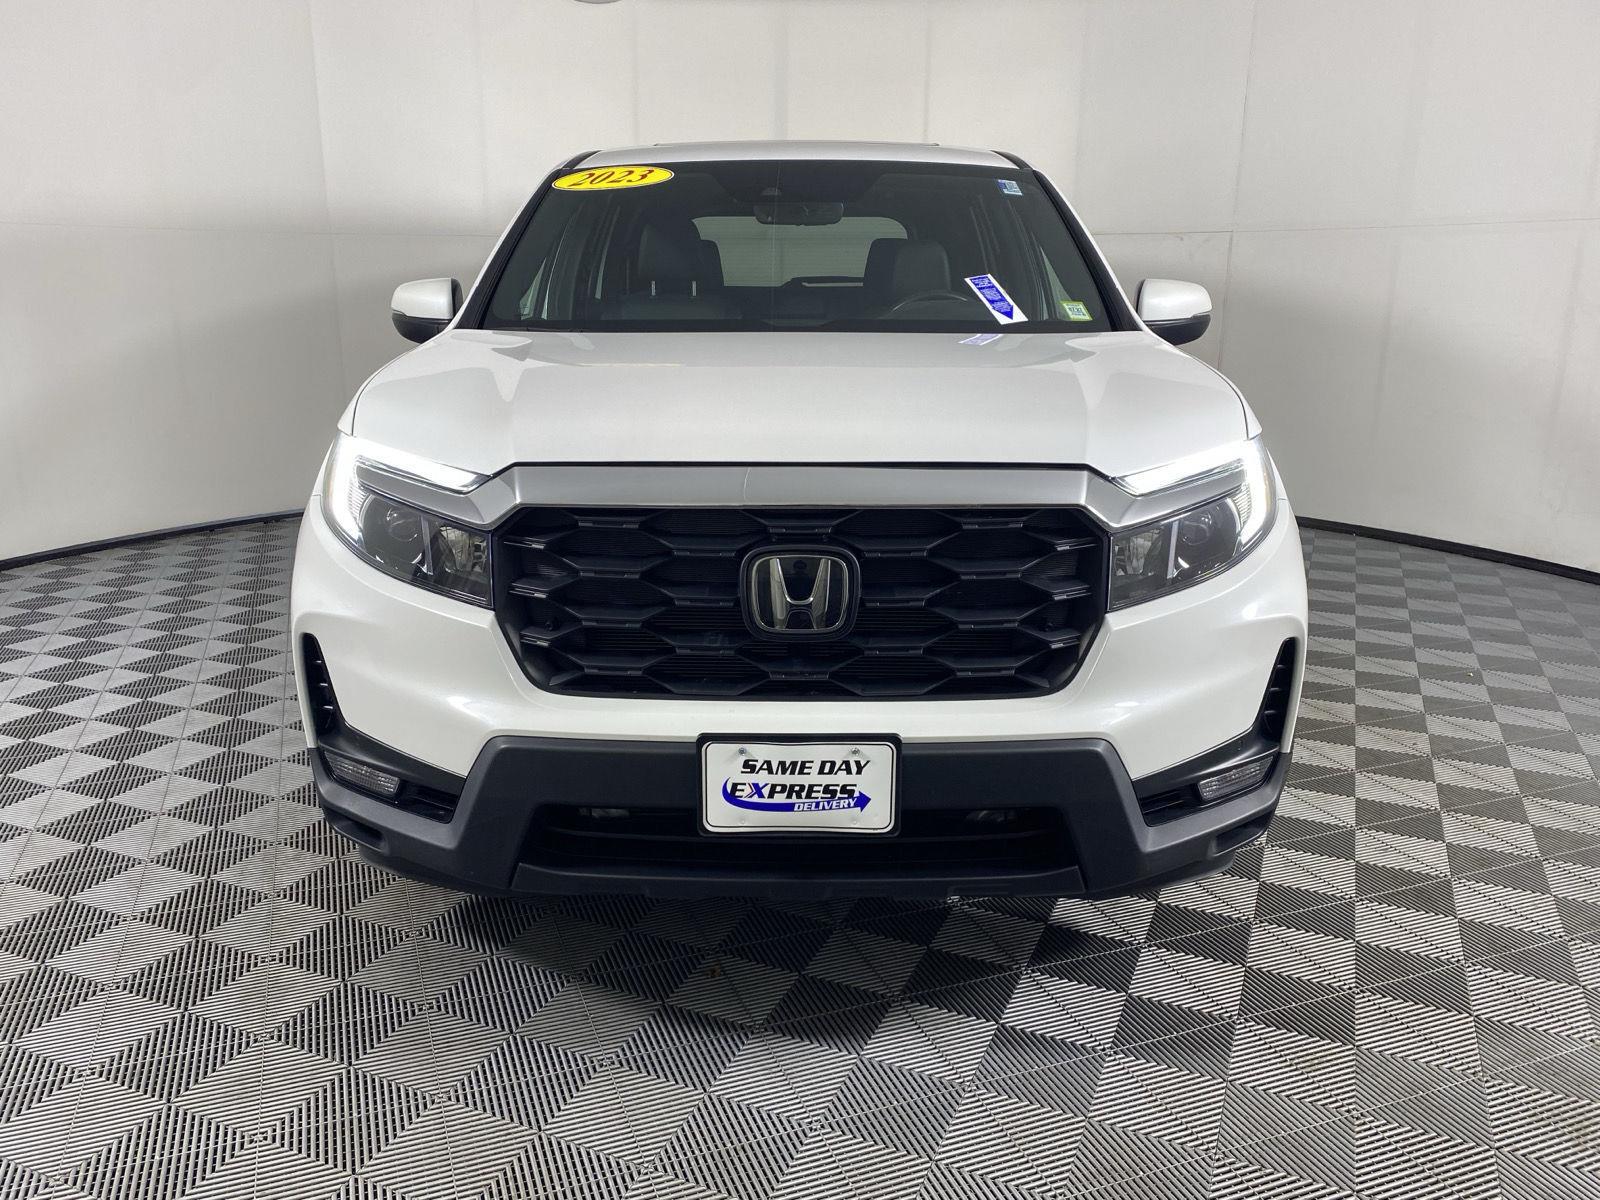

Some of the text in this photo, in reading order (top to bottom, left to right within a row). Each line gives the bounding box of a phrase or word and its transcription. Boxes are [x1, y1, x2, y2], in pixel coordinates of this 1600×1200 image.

[567, 169, 655, 188] 2023
[740, 758, 871, 776] SAME DAY
[729, 782, 858, 800] EXPRESS
[793, 797, 858, 812] DELIVERY
